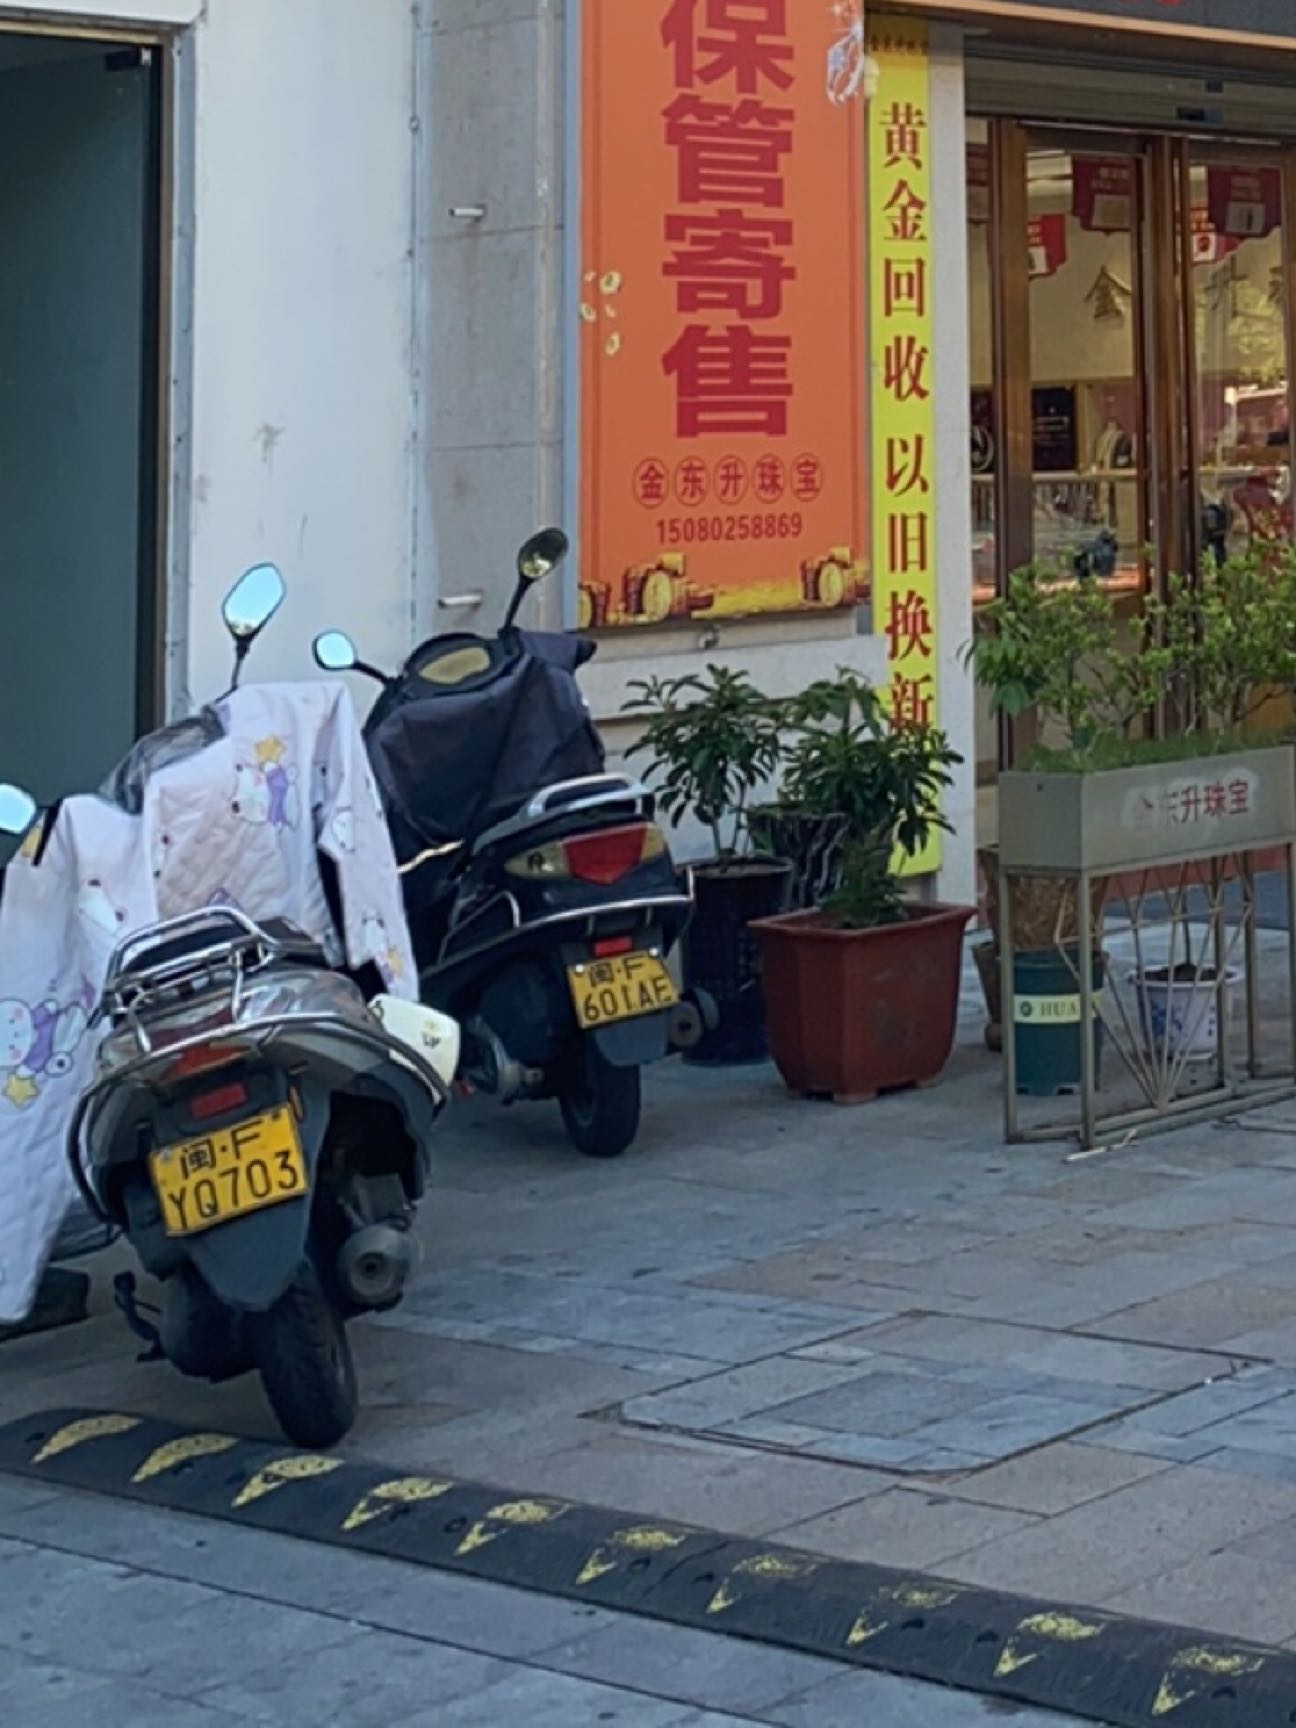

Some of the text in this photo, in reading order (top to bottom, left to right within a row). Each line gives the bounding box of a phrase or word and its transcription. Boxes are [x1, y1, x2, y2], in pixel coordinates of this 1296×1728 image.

[879, 102, 930, 401] 黄金回收
[633, 455, 825, 508] 金东升珠宝
[656, 512, 804, 546] 15080258869
[179, 1118, 263, 1181] 闽·F
[167, 1149, 298, 1230] YQ703
